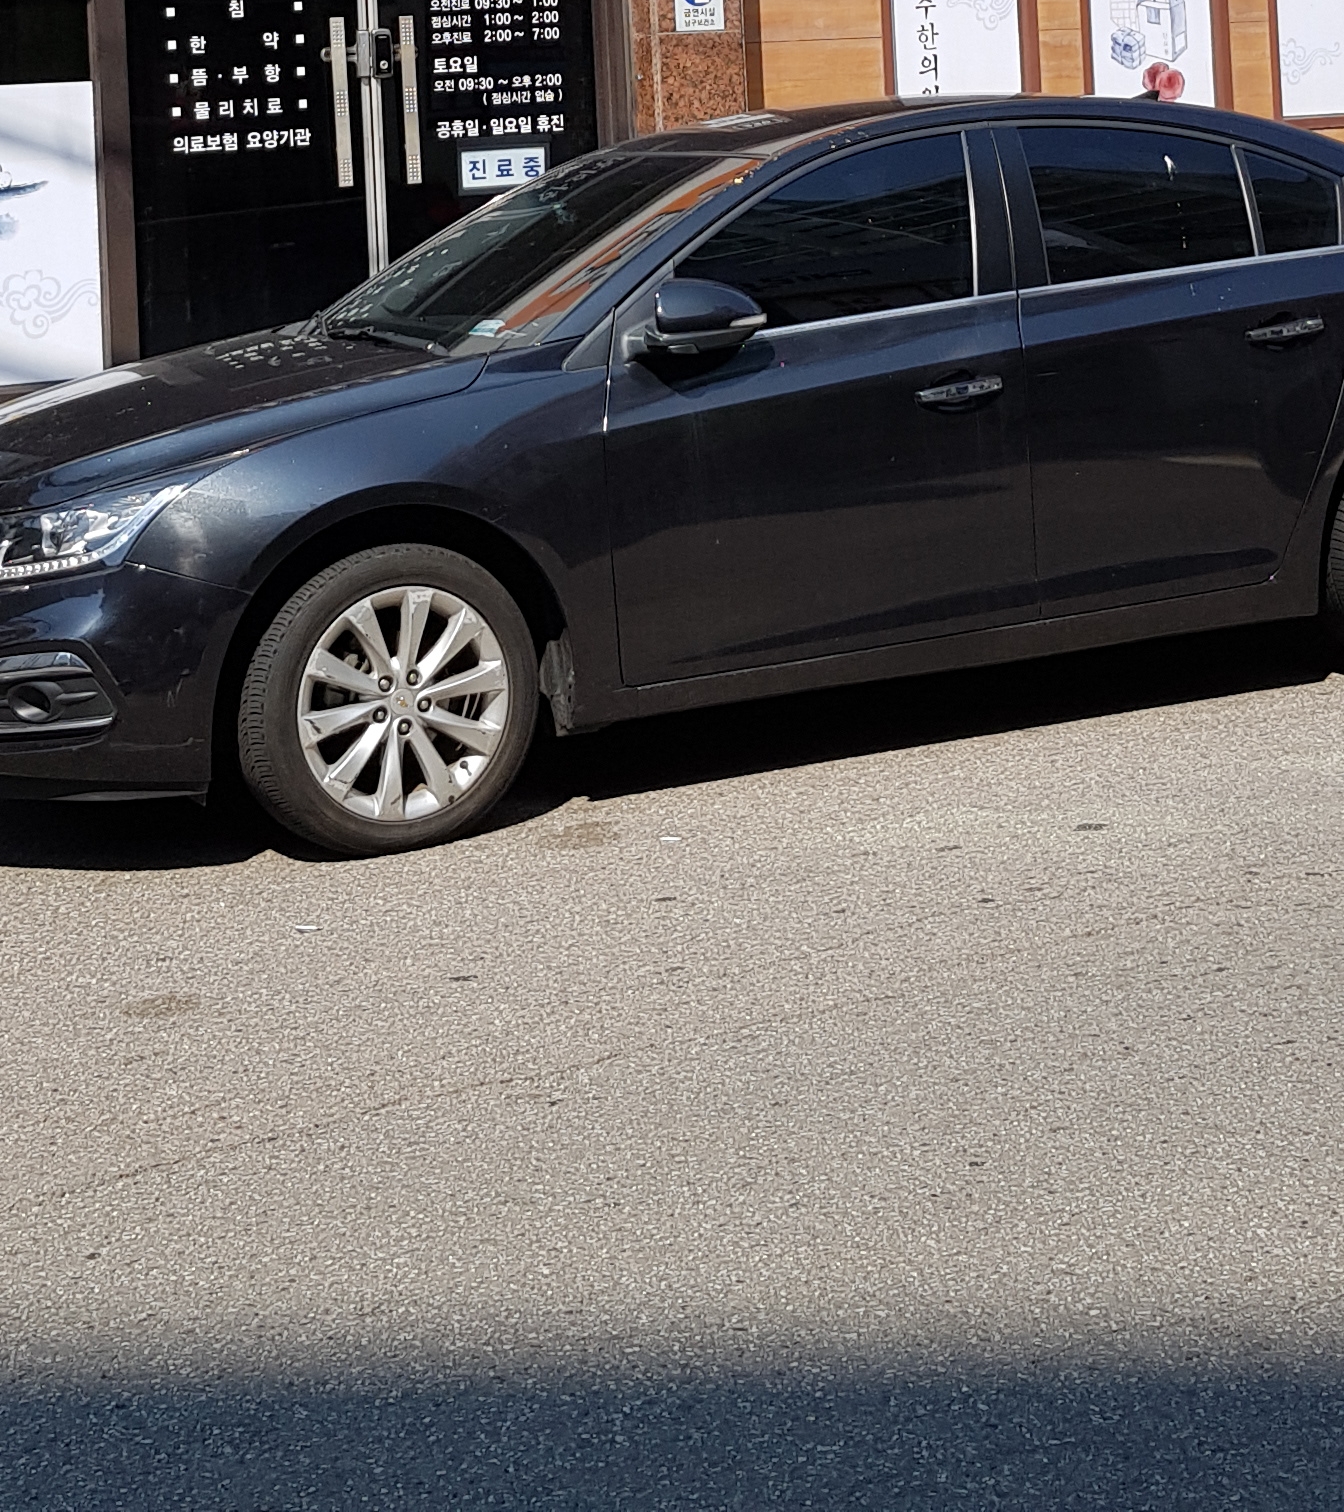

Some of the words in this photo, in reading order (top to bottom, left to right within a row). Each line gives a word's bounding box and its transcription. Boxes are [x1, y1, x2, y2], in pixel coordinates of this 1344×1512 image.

[228, 0, 245, 19] 침
[431, 14, 472, 29] 점심시간
[431, 31, 473, 46] 오후진료
[433, 55, 478, 74] 토요일
[433, 79, 455, 92] 오전
[511, 74, 533, 88] 오후
[534, 73, 563, 87] 2:00
[536, 113, 565, 133] 휴진
[172, 132, 238, 155] 의료보험
[245, 127, 312, 149] 요양기관
